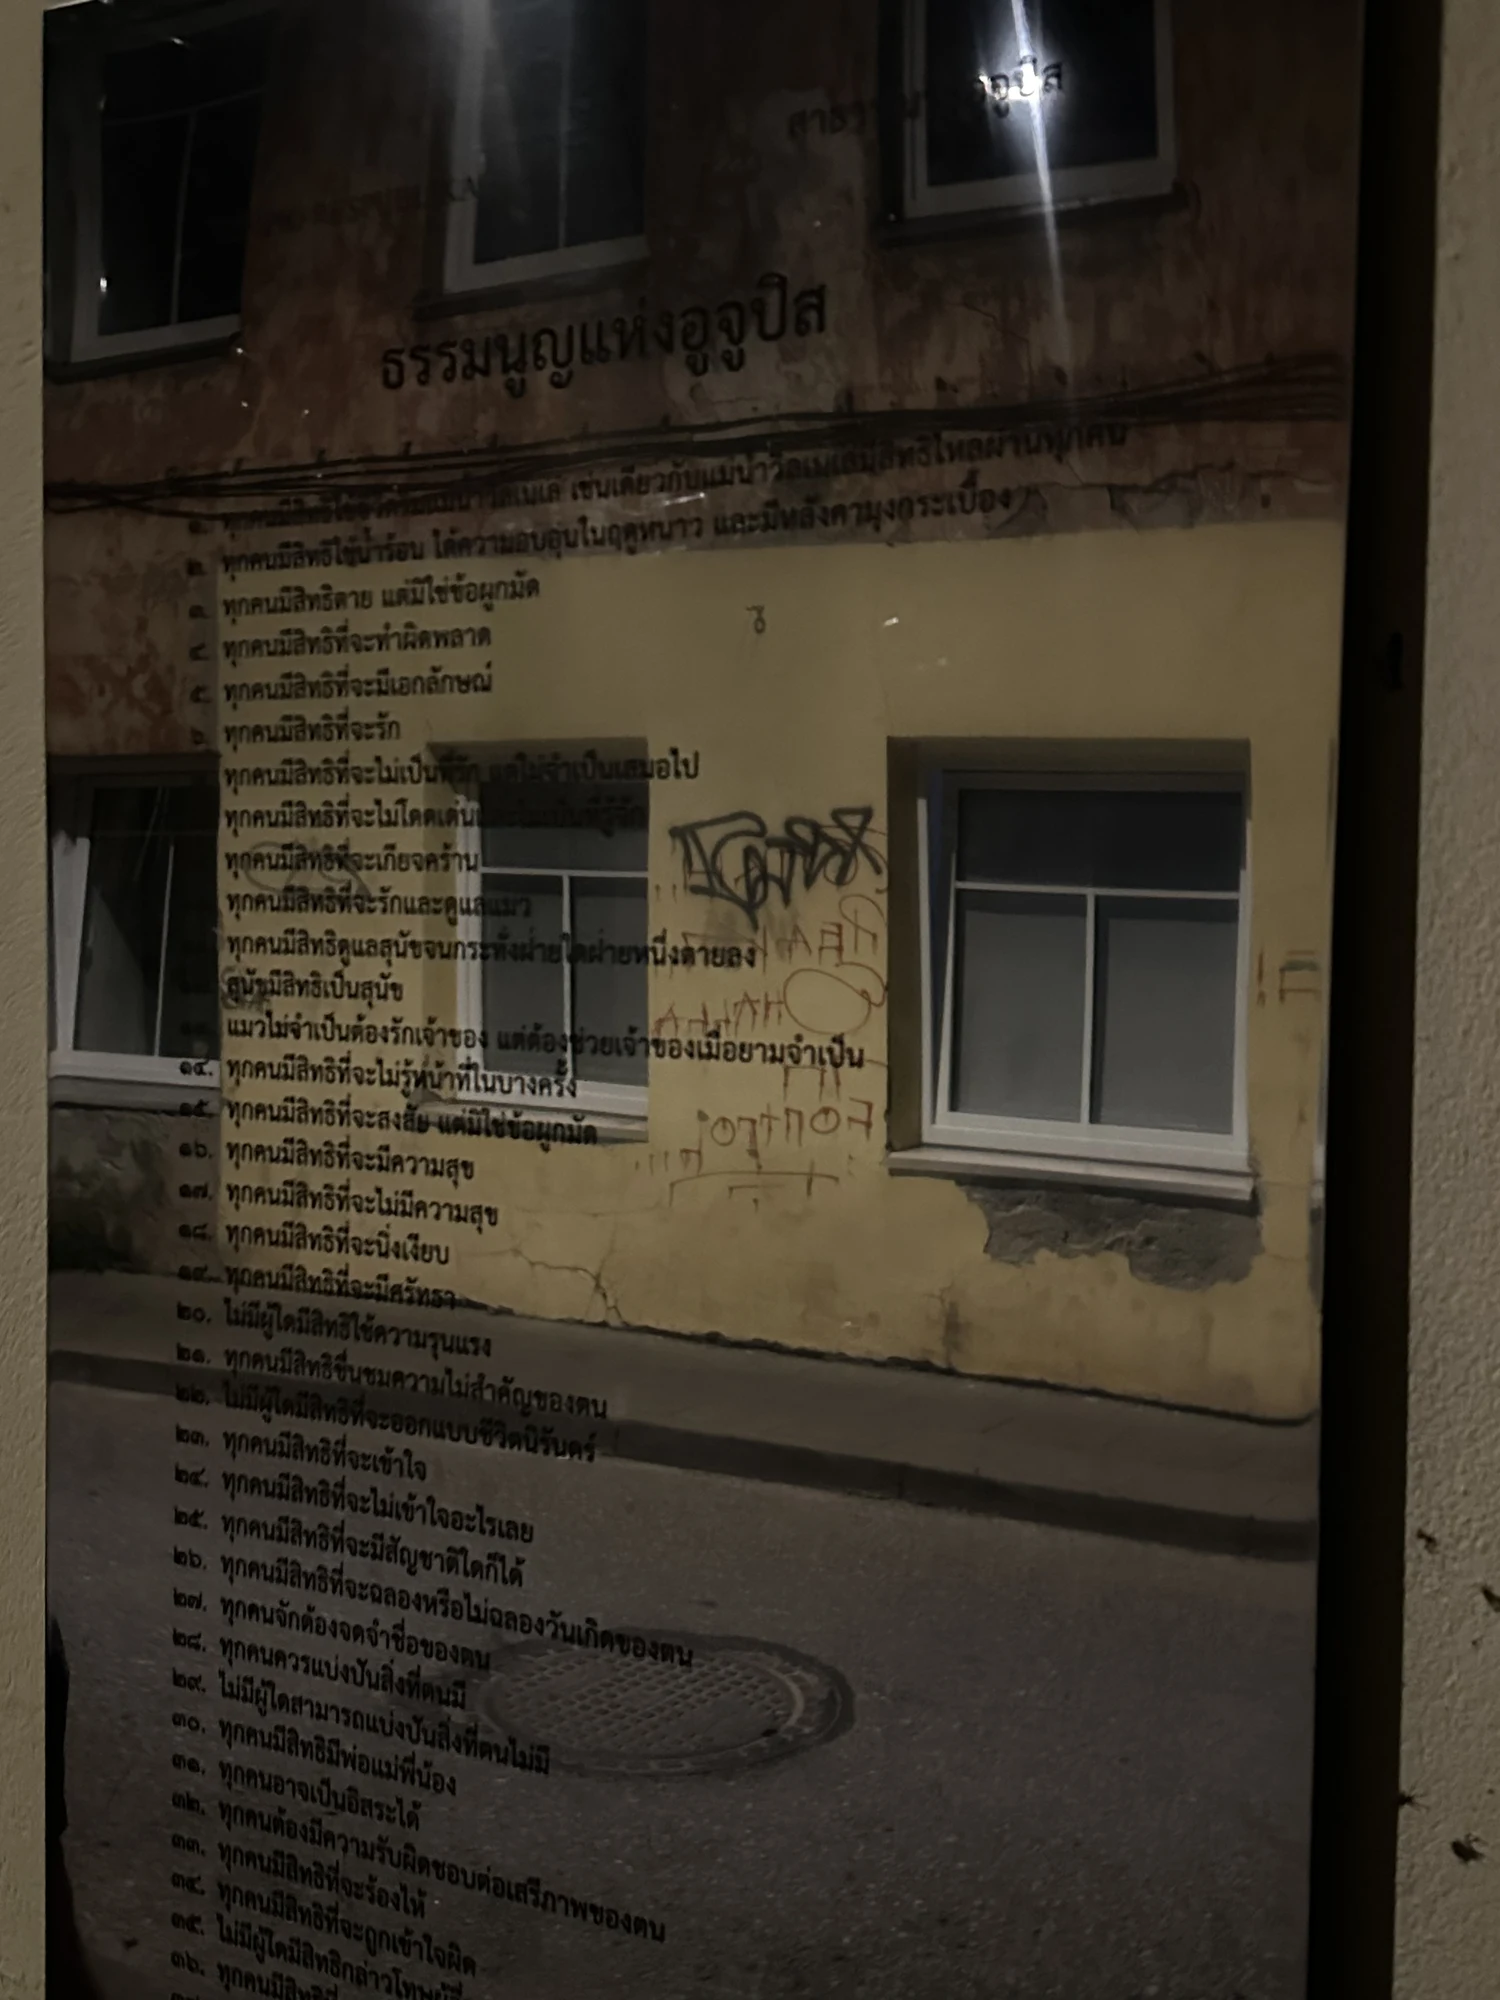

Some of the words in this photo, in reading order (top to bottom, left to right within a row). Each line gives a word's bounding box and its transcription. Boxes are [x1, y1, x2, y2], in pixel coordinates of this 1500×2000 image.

[381, 271, 827, 399] ธรรมนูญแห่งอูจูปิส
[222, 583, 374, 627] ทุกคนมีสิทธิตาย
[222, 618, 492, 667] ทุกคนมีสิทธิที่จะทำผิดพลาด
[223, 660, 493, 711] ทุกคนมีสิทธิที่จะมีเอกลักษณ์
[224, 705, 401, 753] ทุกคนมีสิทธิที่จะรัก
[225, 837, 480, 879] ทุกคนมีสิทธิที่จะเกียจคร้าน
[226, 883, 531, 926] ทุกคนมีสิทธิที่จะรักและดูแลแมว
[226, 967, 405, 1007] สุนัขมีสิทธิเป็นสุนัข
[227, 1011, 488, 1049] แมวไม่จำเป็นต้องรักเจ้าของ
[179, 1055, 214, 1077] ๑๔.
[226, 1050, 578, 1100] ทุกคนมีสิทธิที่จะไม่รู้หน้าที่ในบางครั้ง
[226, 1092, 431, 1132] ทุกคนมีสิทธิที่จะสงสัย
[178, 1138, 214, 1160] ๑๖.
[226, 1134, 476, 1190] ทุกคนมีสิทธิที่จะมีความสุข
[226, 1174, 501, 1234] ทุกคนมีสิทธิที่จะไม่มีความสุข
[225, 1216, 450, 1265] ทุกคนมีสิทธิที่จะนิ่งเงียบ
[224, 1263, 456, 1310] ทุกคนมีสิทธิที่จะมีศรัทธา
[176, 1301, 212, 1324] ๒๐.
[223, 1297, 492, 1360] ไม่มีผู้ใดมีสิทธิใช้ความรุนแรง
[176, 1341, 211, 1365] ๒๑.
[223, 1345, 608, 1420] ทุกคนมีสิทธิชื่นชมความไม่สำคัญของตน
[222, 1379, 598, 1463] ไม่มีผู้ใดมีสิทธิที่จะออกแบบชีวิตนิรันดร์
[174, 1425, 210, 1448] ๒๓.
[222, 1430, 427, 1482] ทุกคนมีสิทธิที่จะเข้าใจ
[173, 1463, 209, 1488] ๒๔.
[221, 1470, 534, 1543] ทุกคนมีสิทธิที่จะไม่เข้าใจอะไรเลย
[173, 1508, 208, 1530] ๒๕.
[220, 1513, 525, 1589] ทุกคนมีสิทธิที่จะมีสัญชาติใดก็ได้
[172, 1587, 207, 1612] ๒๗.
[219, 1594, 491, 1671] ทุกคนจักต้องจดจำชื่อของตน
[173, 1545, 207, 1571] ๒๖.
[219, 1552, 694, 1669] ทุกคนมีสิทธิที่จะฉลองหรือไม่ฉลองวันเกิดของตน
[172, 1628, 207, 1653] ๒๘.
[219, 1634, 467, 1710] ทุกคนควรแบ่งปันสิ่งที่ตนมี
[171, 1667, 206, 1693] ๒๙.
[218, 1669, 551, 1775] ไม่มีผู้ใดสามารถแบ่งปันสิ่งที่ตนไม่มี
[171, 1711, 206, 1735] ๓๐.
[218, 1717, 458, 1797] ทุกคนมีสิทธิมีพ่อแม่พี่น้อง
[171, 1752, 206, 1775] ๓๑.
[218, 1758, 421, 1832] ทุกคนอาจเป็นอิสระได้
[171, 1832, 206, 1856] ๓๓.
[217, 1839, 426, 1919] ทุกคนมีสิทธิที่จะร้องไห้
[218, 1799, 667, 1944] ทุกคนต้องมีความรับผิดชอบต่อเสรีภาพของตน
[217, 1880, 477, 1978] ทุกคนมีสิทธิที่จะถูกเข้าใจผิด
[170, 1950, 205, 1977] ๓๖.
